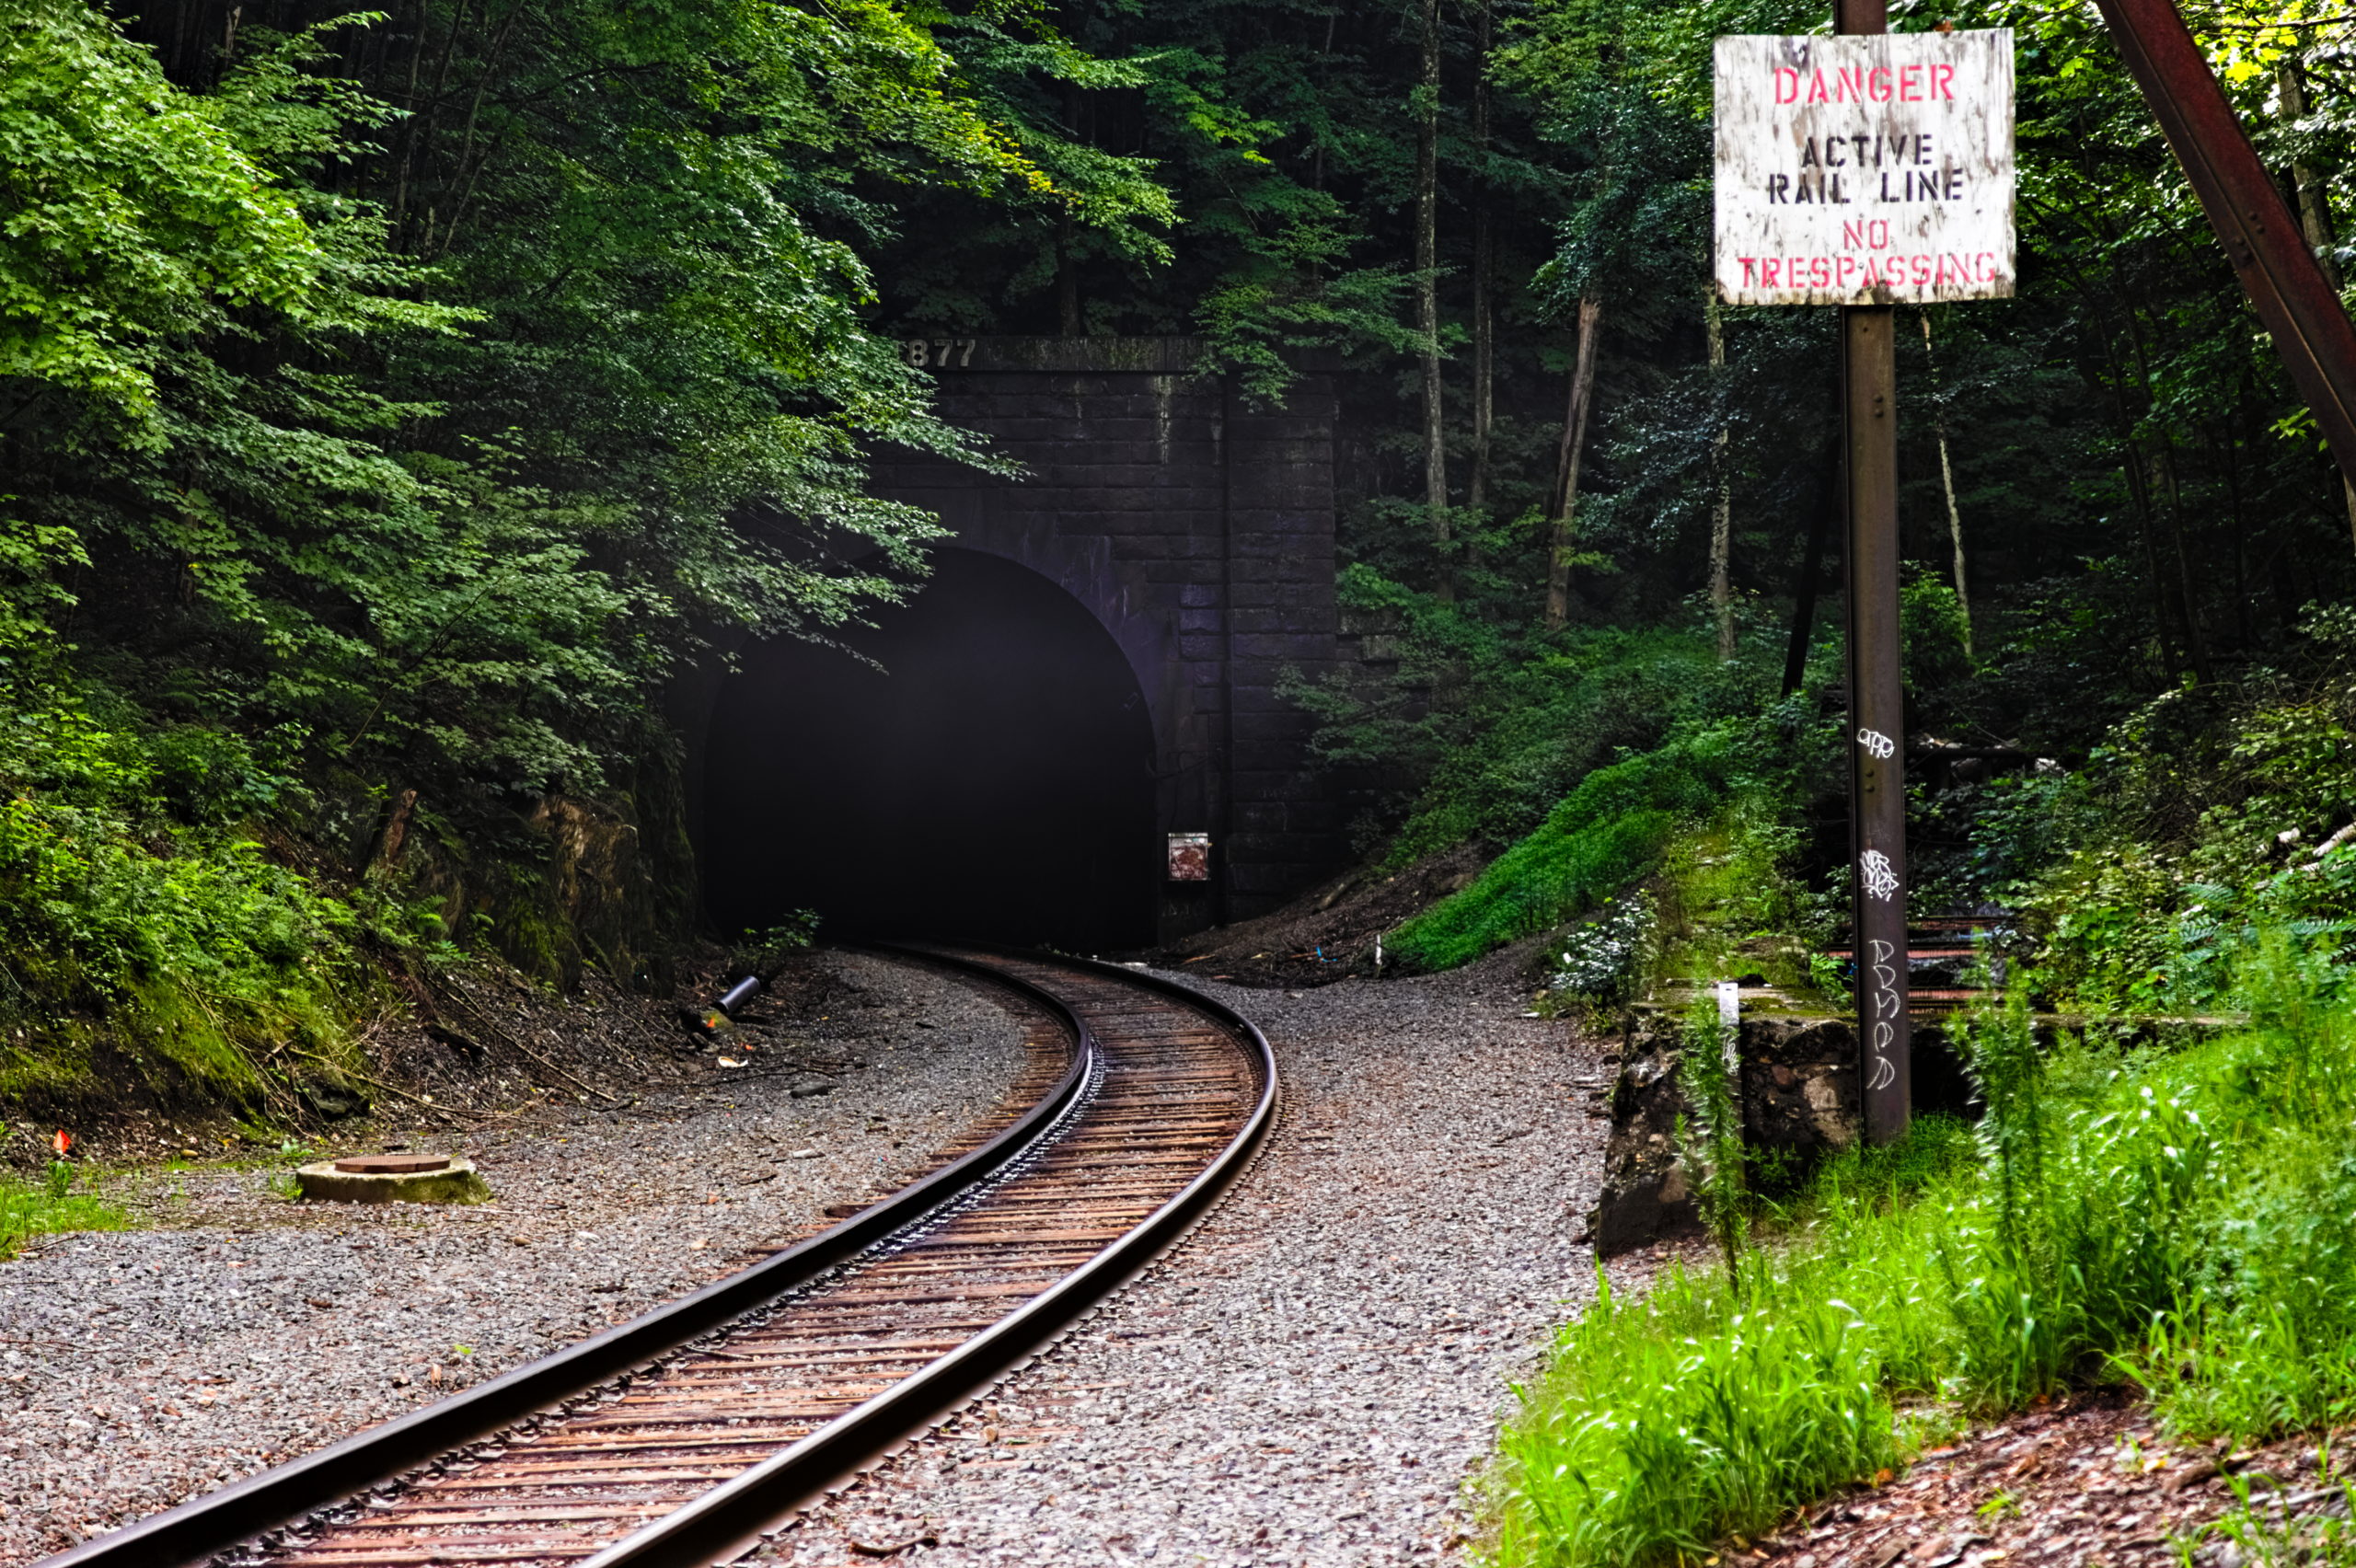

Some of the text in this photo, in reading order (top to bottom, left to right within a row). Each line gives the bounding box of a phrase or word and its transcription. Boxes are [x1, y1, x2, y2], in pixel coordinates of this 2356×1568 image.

[1773, 63, 1955, 104] DANGER
[1802, 133, 1933, 168] ACTIVE
[1769, 168, 1963, 204] RAIL LINE
[1842, 219, 1888, 250] NO
[1738, 252, 1996, 288] TRESPASSING
